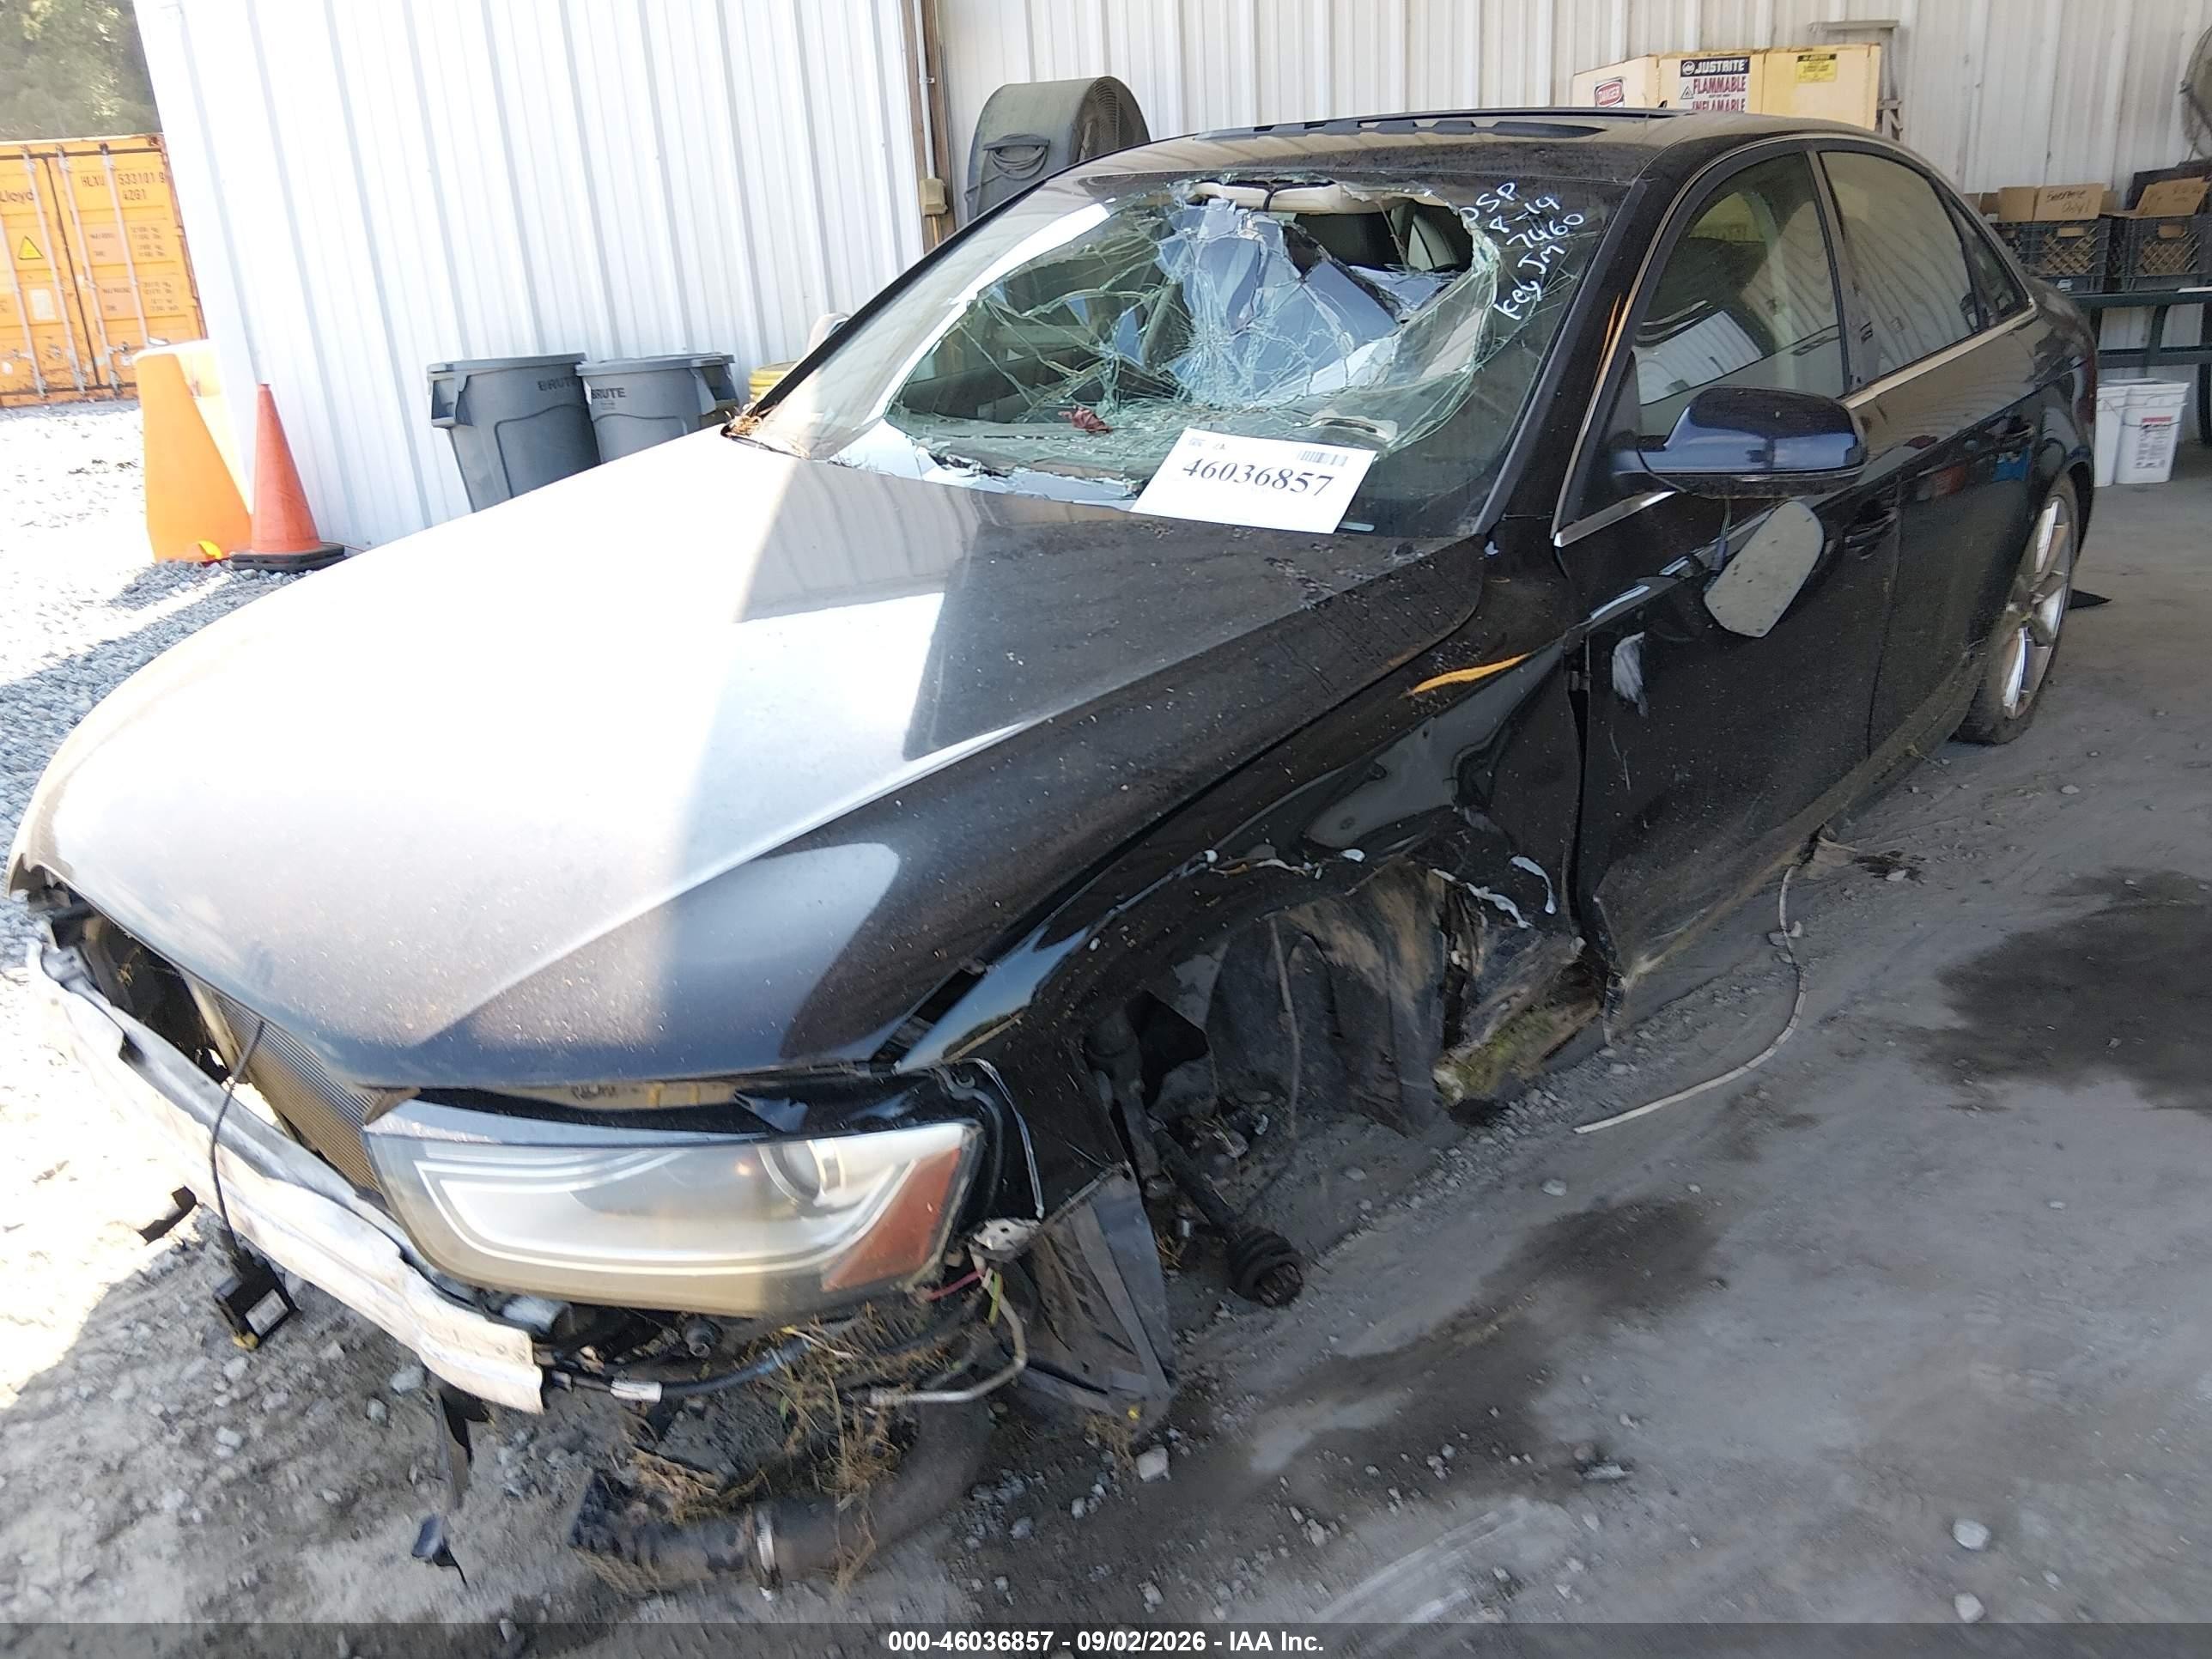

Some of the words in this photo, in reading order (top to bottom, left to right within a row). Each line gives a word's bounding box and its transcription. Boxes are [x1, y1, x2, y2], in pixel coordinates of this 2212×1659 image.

[1694, 59, 1746, 75] JUSTRITE
[1693, 76, 1747, 94] FLAMMABLE
[1505, 212, 1585, 249] 7460
[591, 387, 627, 399] BRUTE
[1182, 458, 1334, 496] 46036857
